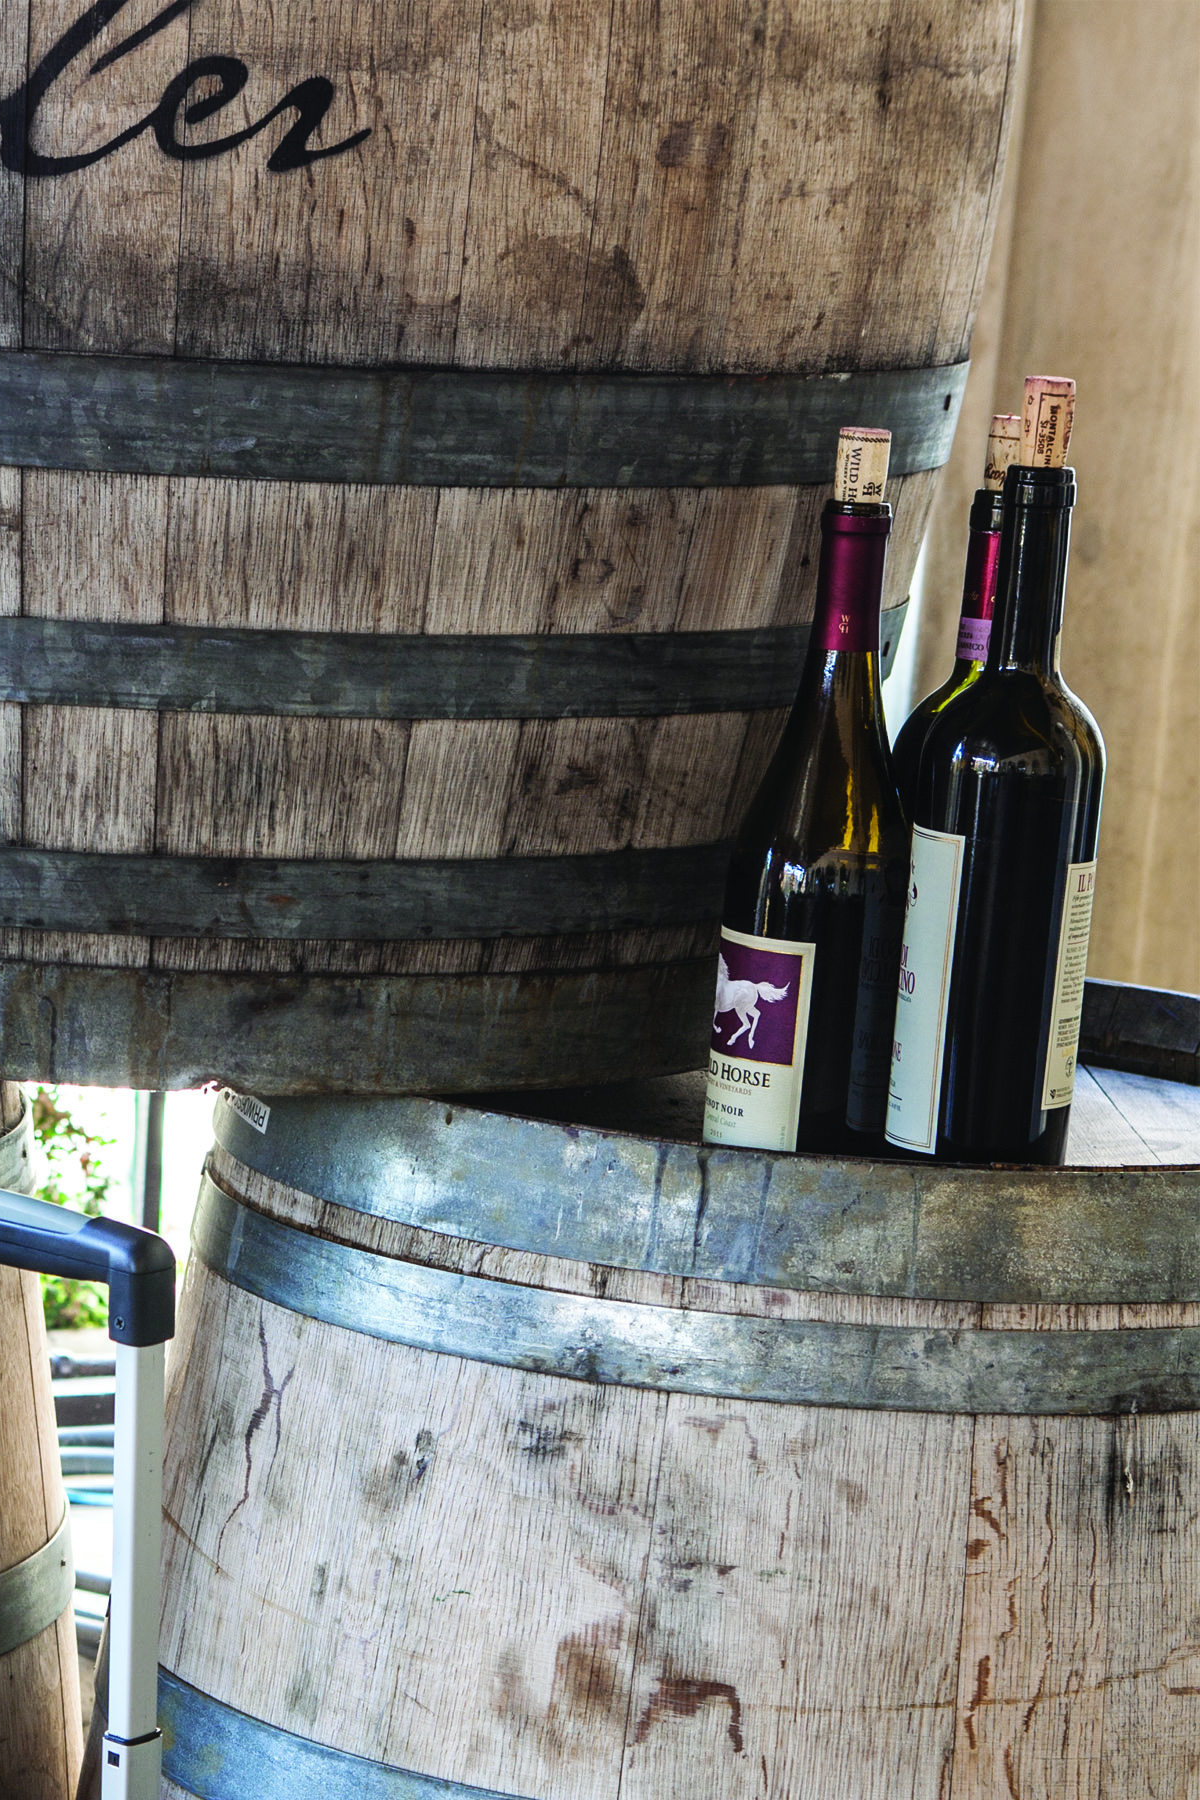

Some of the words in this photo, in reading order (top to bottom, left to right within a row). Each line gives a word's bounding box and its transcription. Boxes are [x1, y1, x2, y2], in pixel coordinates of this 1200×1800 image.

[1043, 403, 1060, 468] MONTALCIN
[848, 447, 863, 484] WILD
[721, 1062, 771, 1088] HORSE
[719, 1081, 752, 1096] VINEYARDS
[720, 1103, 744, 1118] NOIR
